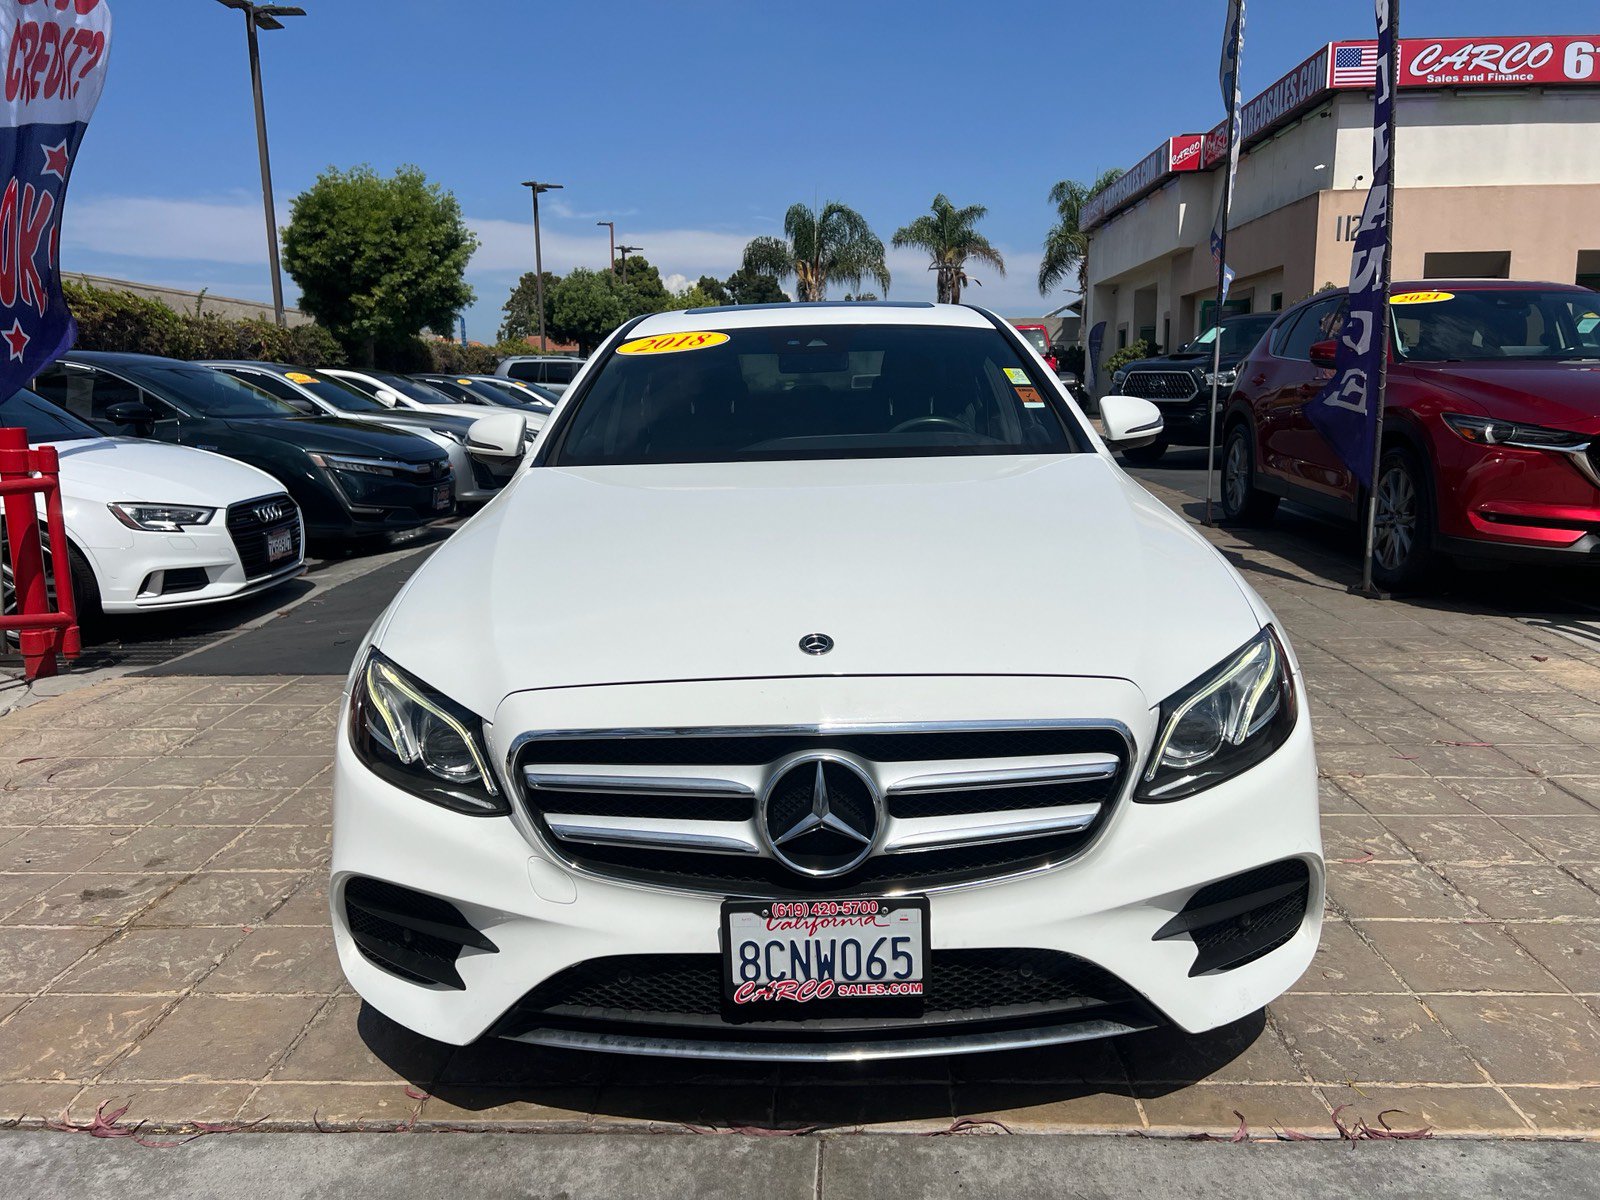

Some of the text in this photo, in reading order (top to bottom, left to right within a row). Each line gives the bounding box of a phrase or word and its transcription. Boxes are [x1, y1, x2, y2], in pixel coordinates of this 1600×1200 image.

[5, 18, 105, 106] CREDIT?
[1408, 41, 1600, 80] CARCO 6
[1426, 72, 1534, 83] Sales and Finance
[1240, 48, 1328, 140] ARCOSALES.COM
[1171, 141, 1200, 165] CARCO
[1398, 293, 1440, 303] 2021
[633, 334, 712, 353] 2018
[771, 900, 879, 918] (619) 420-5700
[766, 914, 890, 937] California
[739, 936, 913, 982] 8CNW065
[733, 979, 924, 1005] CARCO SALES.COM
